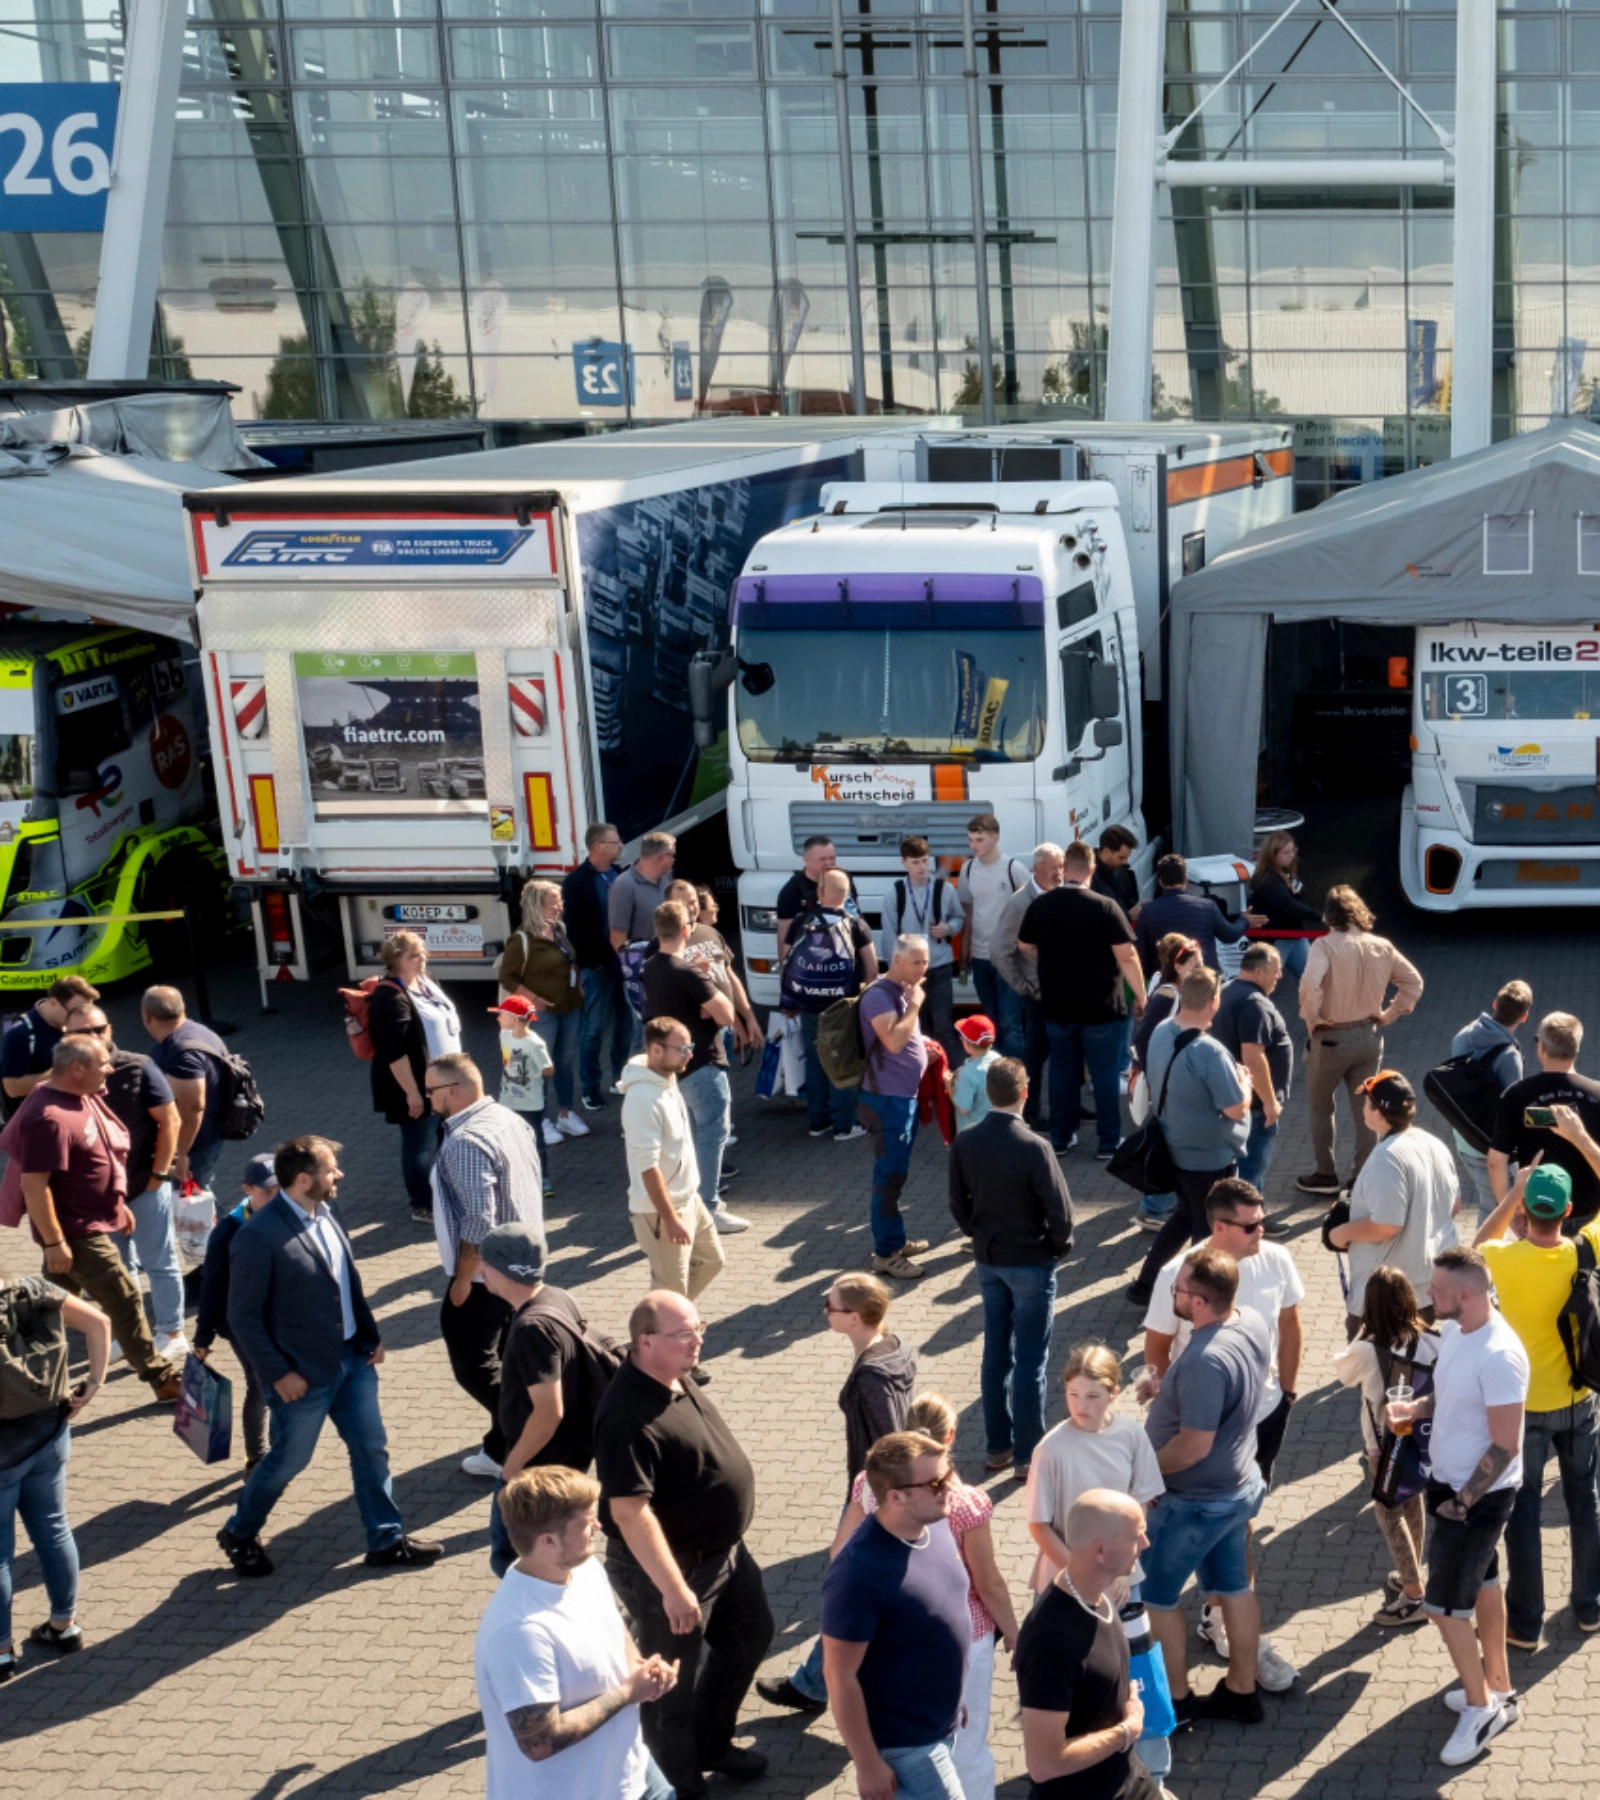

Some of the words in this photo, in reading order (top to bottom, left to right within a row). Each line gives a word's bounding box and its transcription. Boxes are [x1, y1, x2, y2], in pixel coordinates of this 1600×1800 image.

[0, 112, 110, 195] 26
[1303, 436, 1324, 446] and
[1328, 436, 1369, 448] Special
[300, 534, 362, 544] GOODYEAR
[413, 541, 461, 549] EUROPEAN
[61, 647, 101, 676] BFT
[75, 681, 115, 703] VARTA
[1455, 679, 1476, 712] 3
[343, 726, 446, 743] fiaetrc.com
[1488, 753, 1549, 764] Prangenberg
[811, 765, 873, 785] Kursch
[824, 783, 916, 801] Kurtscheid
[1504, 803, 1593, 820] MAN
[402, 907, 419, 918] KO
[804, 986, 845, 996] VARTA
